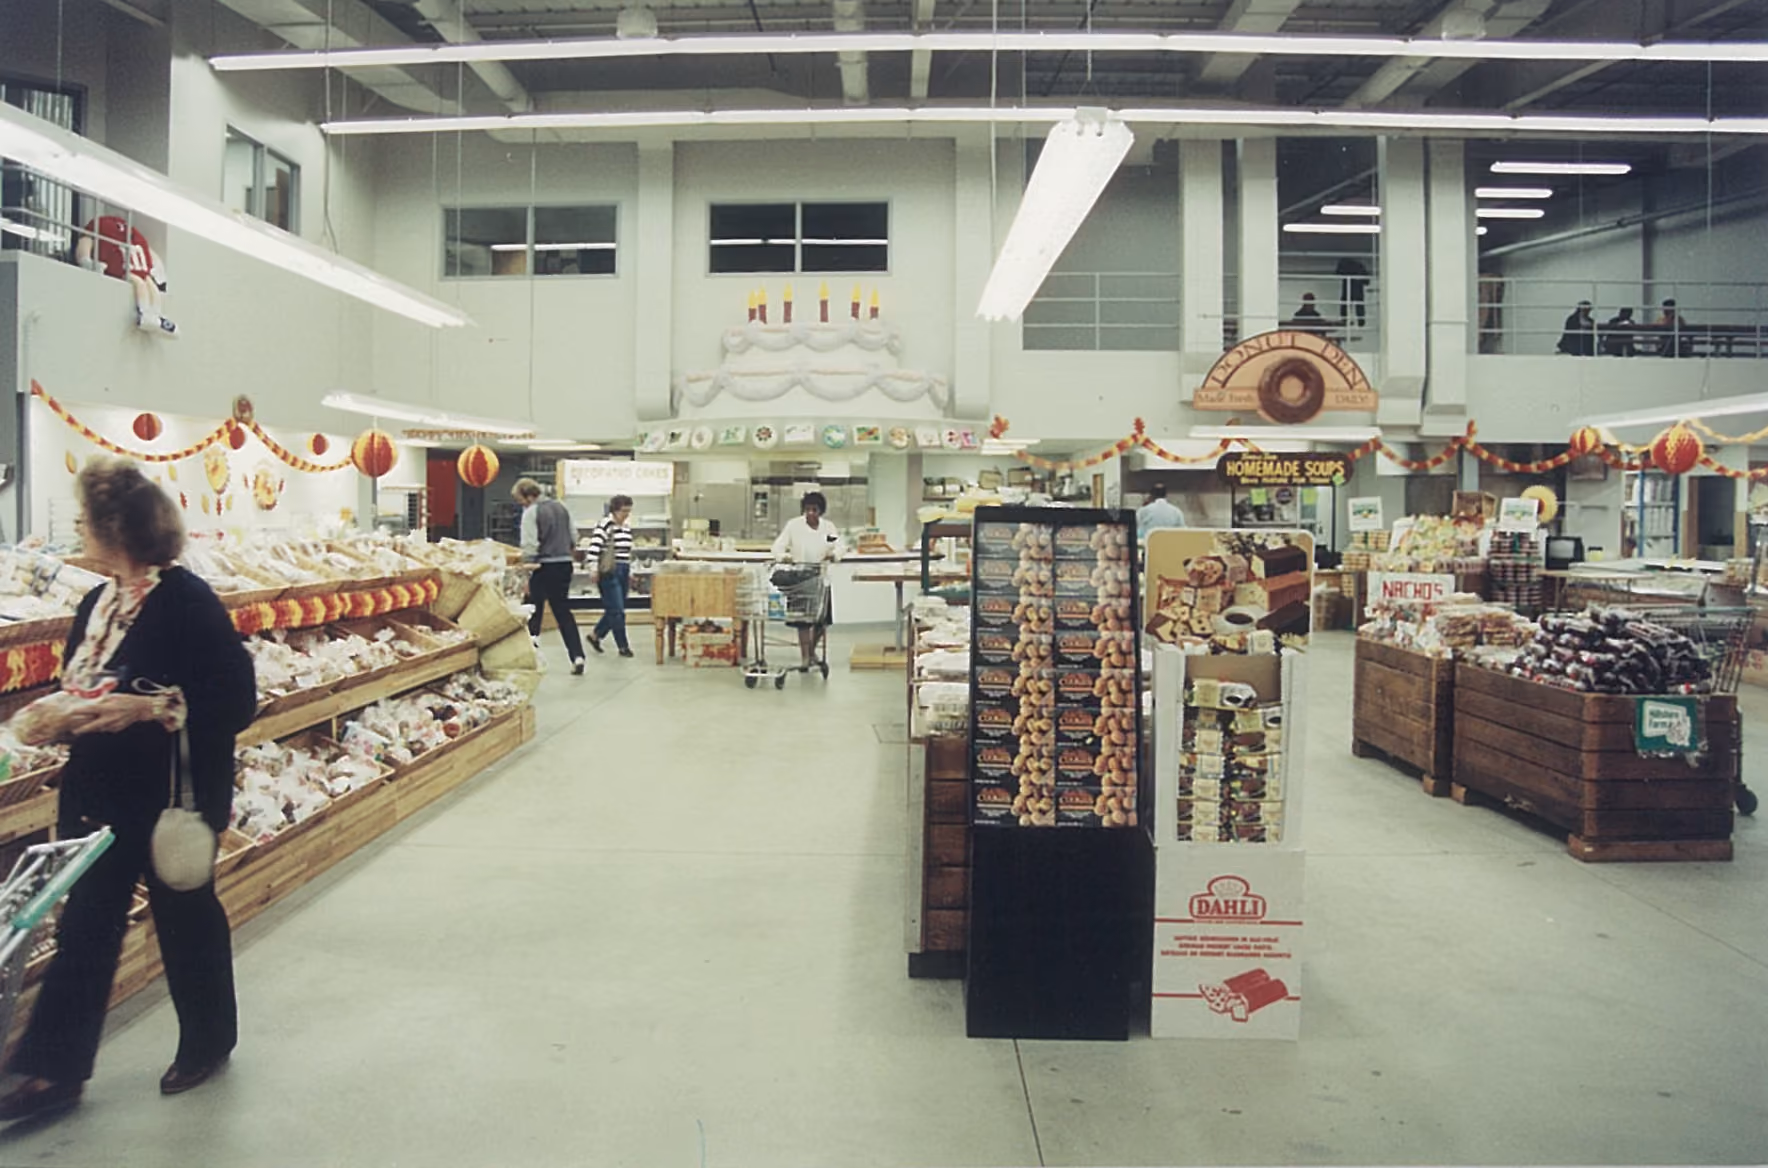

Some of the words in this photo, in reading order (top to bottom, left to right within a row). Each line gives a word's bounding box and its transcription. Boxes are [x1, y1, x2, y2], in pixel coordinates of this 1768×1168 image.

[1210, 333, 1296, 386] DONUT
[1320, 342, 1364, 387] DEN
[636, 467, 669, 480] CAKES
[1226, 460, 1300, 477] HOMEMADE
[1304, 460, 1345, 477] SOUPS
[1382, 580, 1443, 600] NACHOS
[1197, 899, 1259, 915] DAHLI
